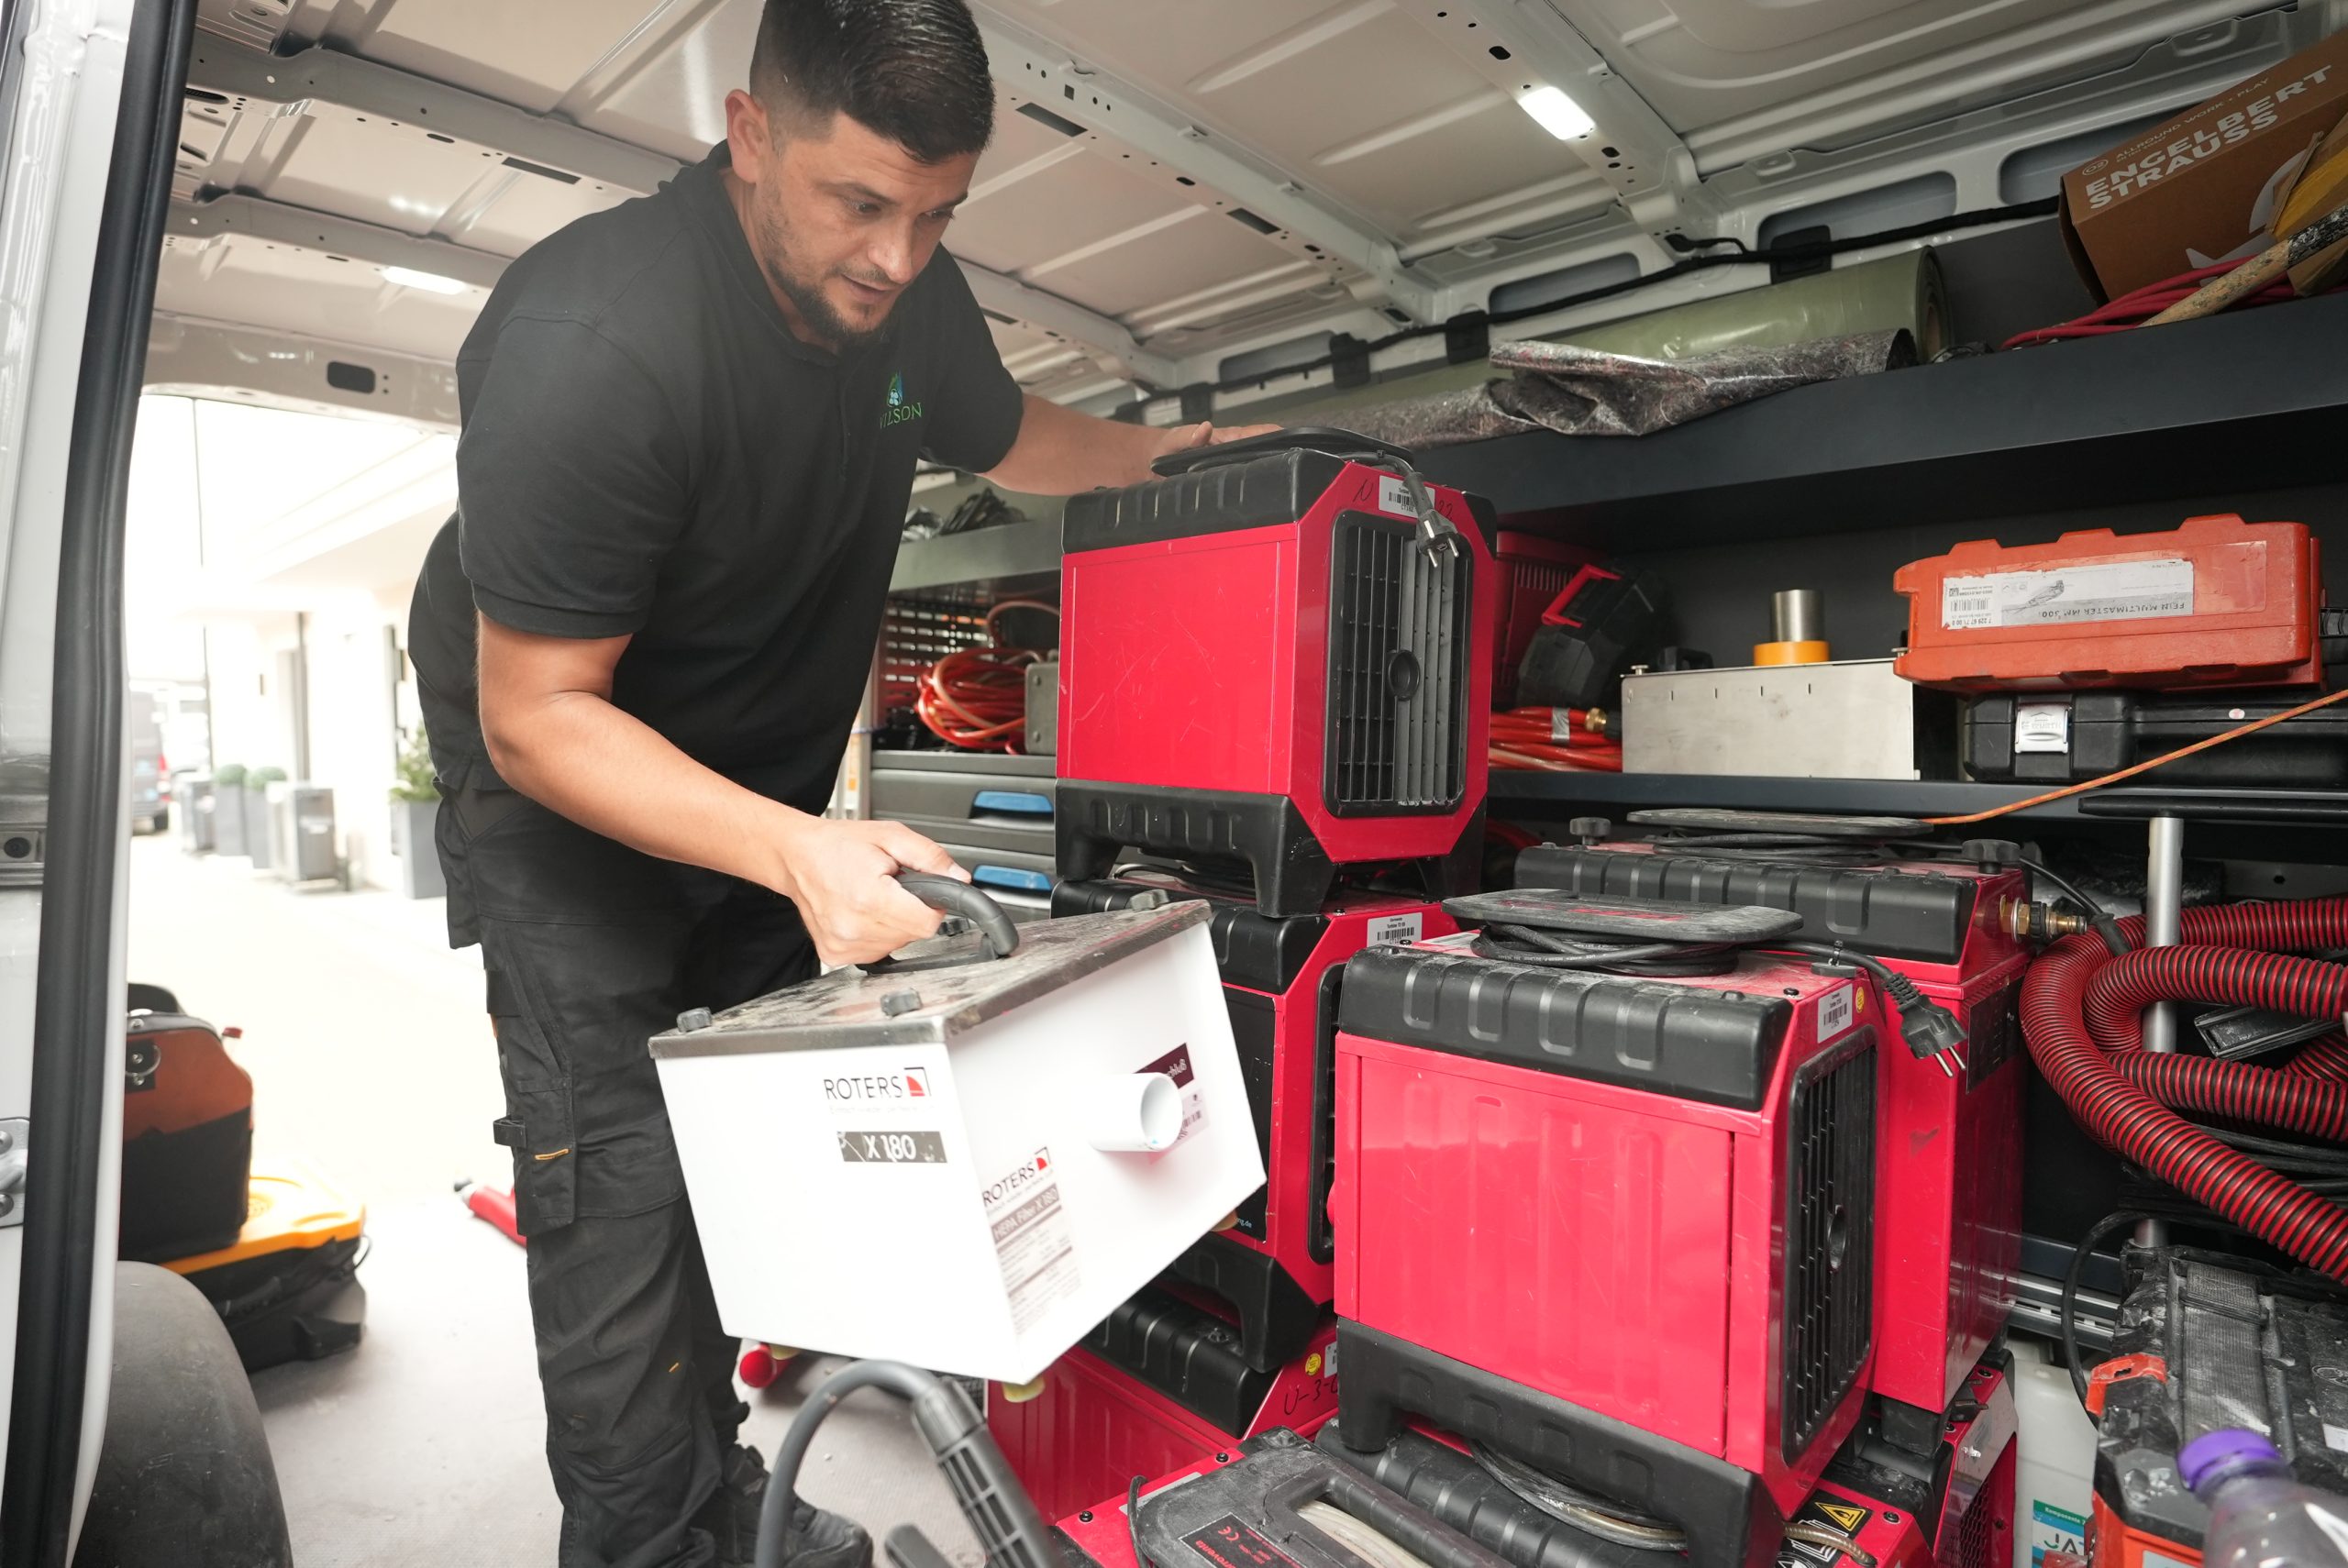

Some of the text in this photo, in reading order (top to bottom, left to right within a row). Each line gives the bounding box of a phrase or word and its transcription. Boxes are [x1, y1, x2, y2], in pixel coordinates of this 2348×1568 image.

[2087, 65, 2331, 198] ENGELBERT
[2116, 124, 2182, 159] ALLROUND
[2185, 102, 2225, 124] WORK
[2237, 77, 2269, 98] PLAY
[2089, 113, 2278, 210] STRAUSS
[2084, 604, 2157, 616] MULTIMASTER
[2161, 602, 2185, 611] FEIN
[823, 1076, 903, 1100] ROTERS
[864, 1134, 916, 1161] X 180
[982, 1162, 1036, 1207] ROTERS
[2043, 1532, 2084, 1554] JA
